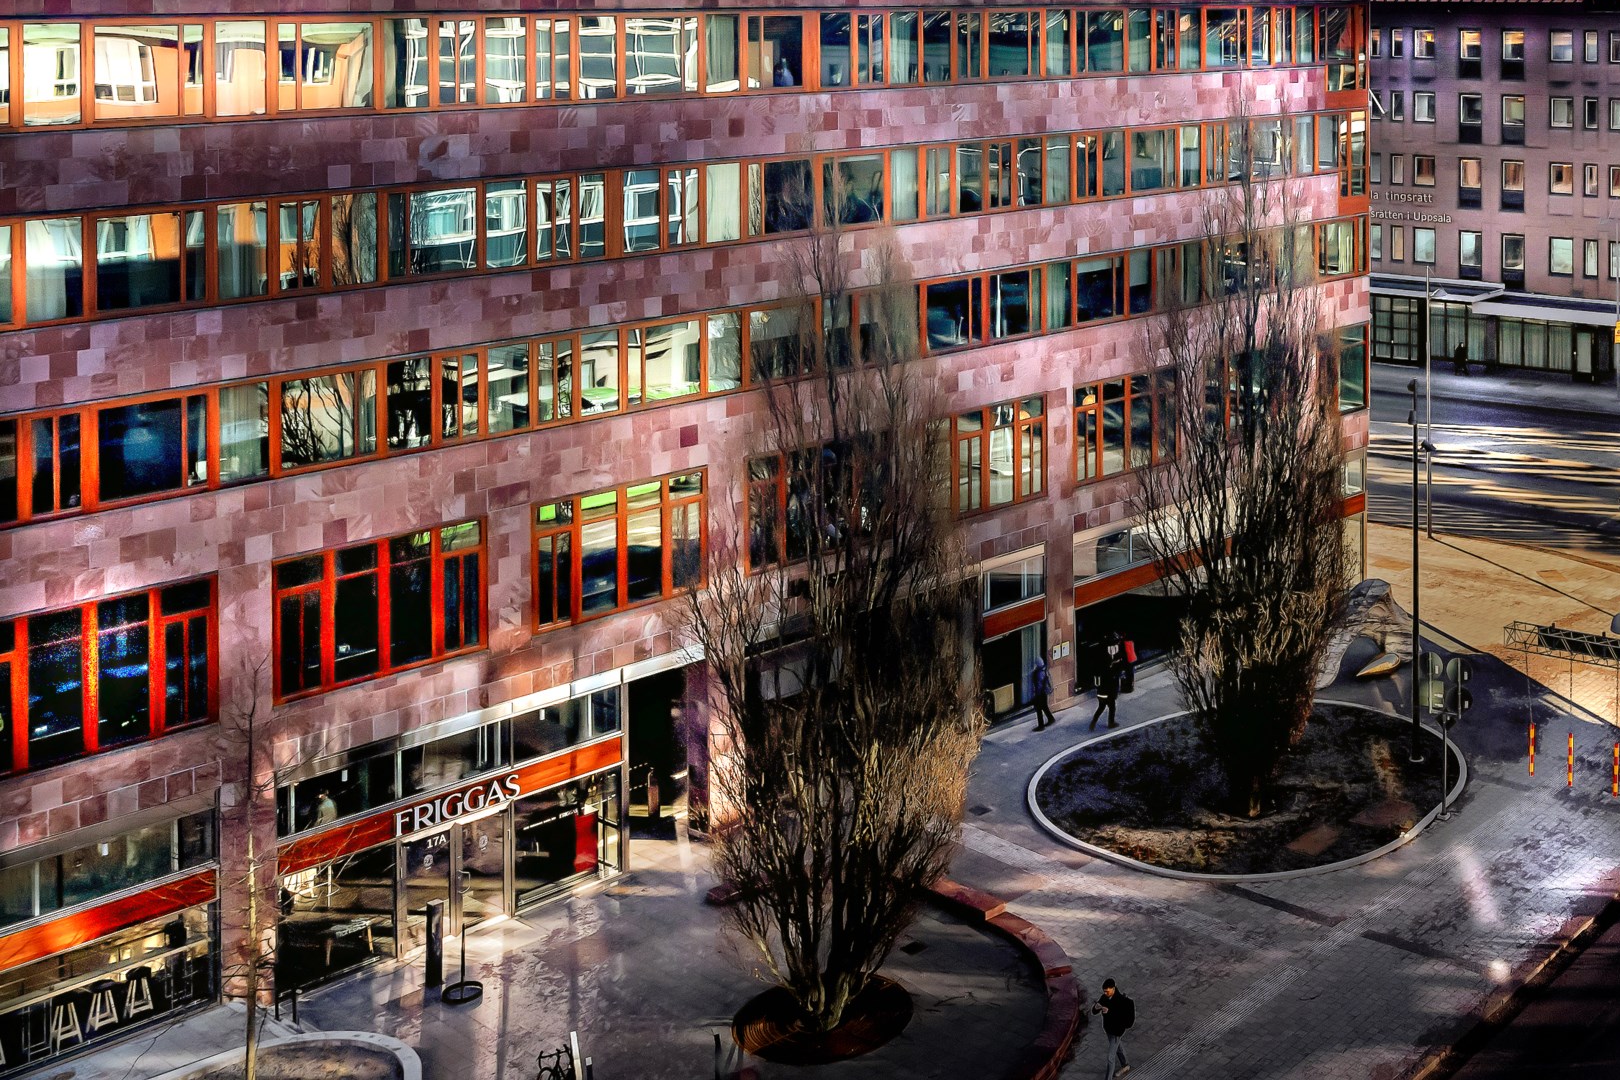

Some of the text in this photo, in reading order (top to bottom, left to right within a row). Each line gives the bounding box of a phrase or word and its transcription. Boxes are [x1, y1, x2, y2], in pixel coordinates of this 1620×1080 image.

[1370, 209, 1404, 220] srätten
[1413, 212, 1452, 223] Uppsala
[396, 774, 521, 837] FRIGGAS
[426, 834, 447, 849] 17A
